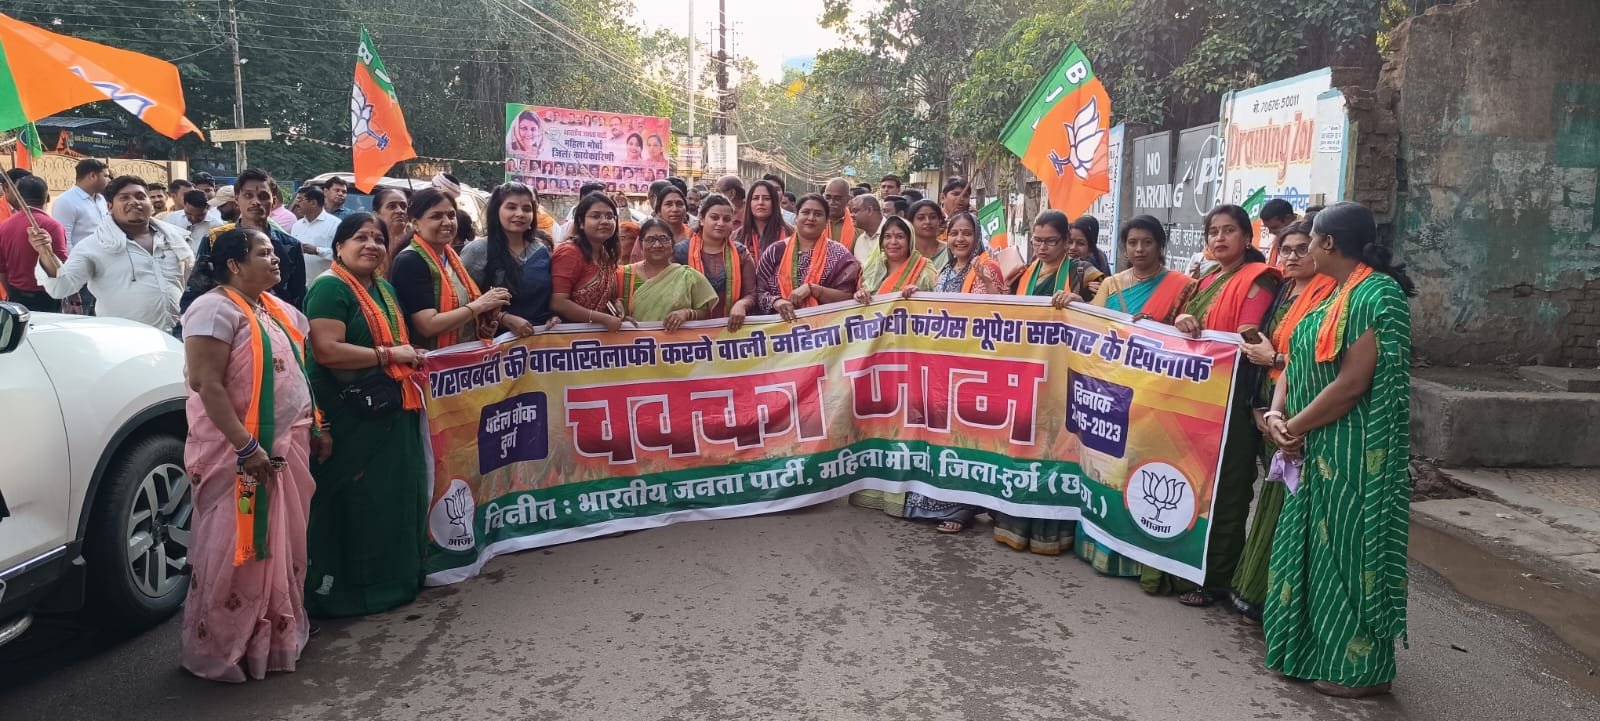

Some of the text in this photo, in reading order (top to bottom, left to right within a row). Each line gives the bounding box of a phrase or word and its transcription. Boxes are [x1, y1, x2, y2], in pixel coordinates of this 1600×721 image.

[552, 147, 571, 158] जिला
[564, 138, 585, 148] महिला
[1228, 117, 1291, 185] Drawing
[1146, 151, 1161, 176] NO
[1135, 183, 1184, 208] PARKING
[503, 345, 527, 379] की
[529, 337, 657, 373] वादाखिलाफी
[661, 335, 712, 364] करने
[717, 330, 767, 361] वाली
[771, 324, 841, 354] महिला
[845, 308, 909, 343] विरोधी
[911, 308, 968, 339] कांग्रेस
[972, 312, 1024, 350] भूपेश
[1026, 321, 1100, 355] सरकार
[1100, 329, 1124, 361] के
[1126, 334, 1213, 382] खिलाफ
[564, 352, 1048, 465] चक्का जाम
[1074, 380, 1115, 414] दिनांक
[485, 409, 511, 434] पटेल
[500, 426, 518, 459] दुर्ग
[485, 493, 557, 535] विनीत
[578, 479, 668, 513] भारतीय
[672, 473, 745, 500] जनता
[818, 448, 883, 479] महिला
[1140, 516, 1171, 533] भाजपा
